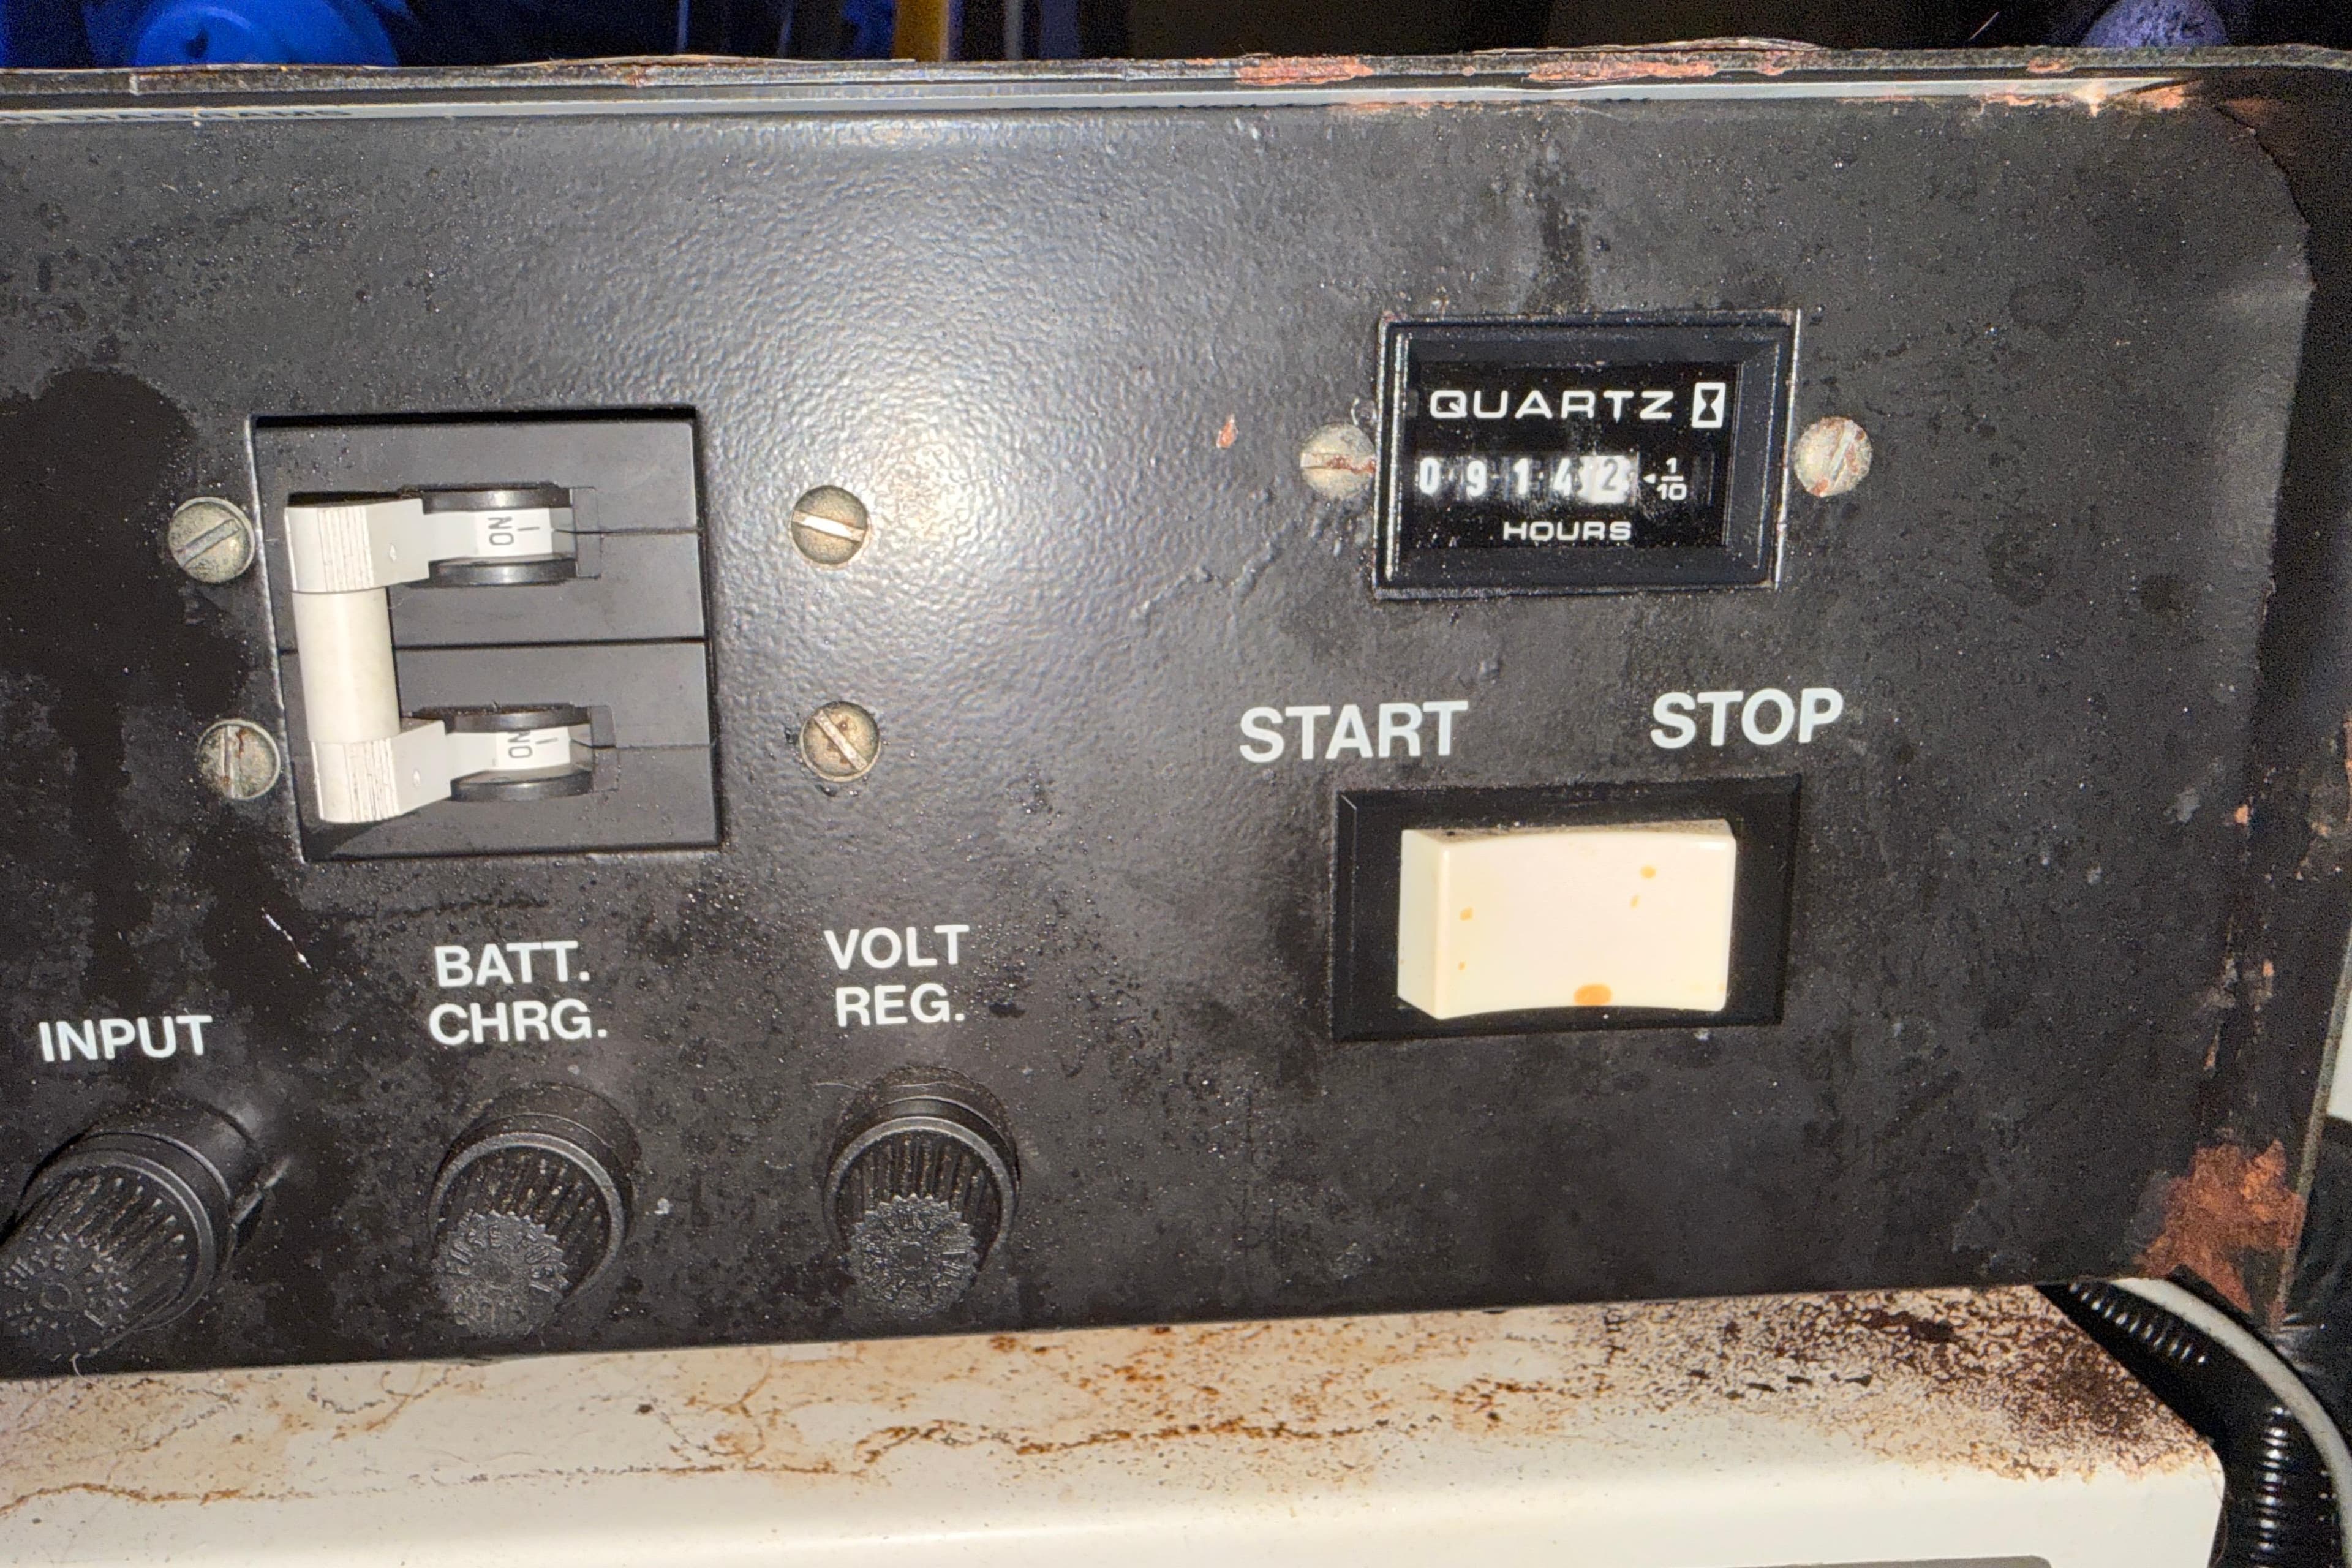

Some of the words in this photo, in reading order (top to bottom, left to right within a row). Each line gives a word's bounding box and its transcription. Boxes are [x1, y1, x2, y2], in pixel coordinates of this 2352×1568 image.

[1430, 389, 1674, 421] QUARTZ
[488, 516, 514, 546] ON
[1502, 521, 1632, 542] HOURS
[1238, 699, 1470, 764] START
[1649, 687, 1845, 750] STOP
[433, 940, 592, 989] BATT.
[823, 923, 971, 971] VOLT
[428, 997, 609, 1046] CHRG.
[834, 982, 966, 1028] REG.
[38, 1014, 213, 1063] INPUT
